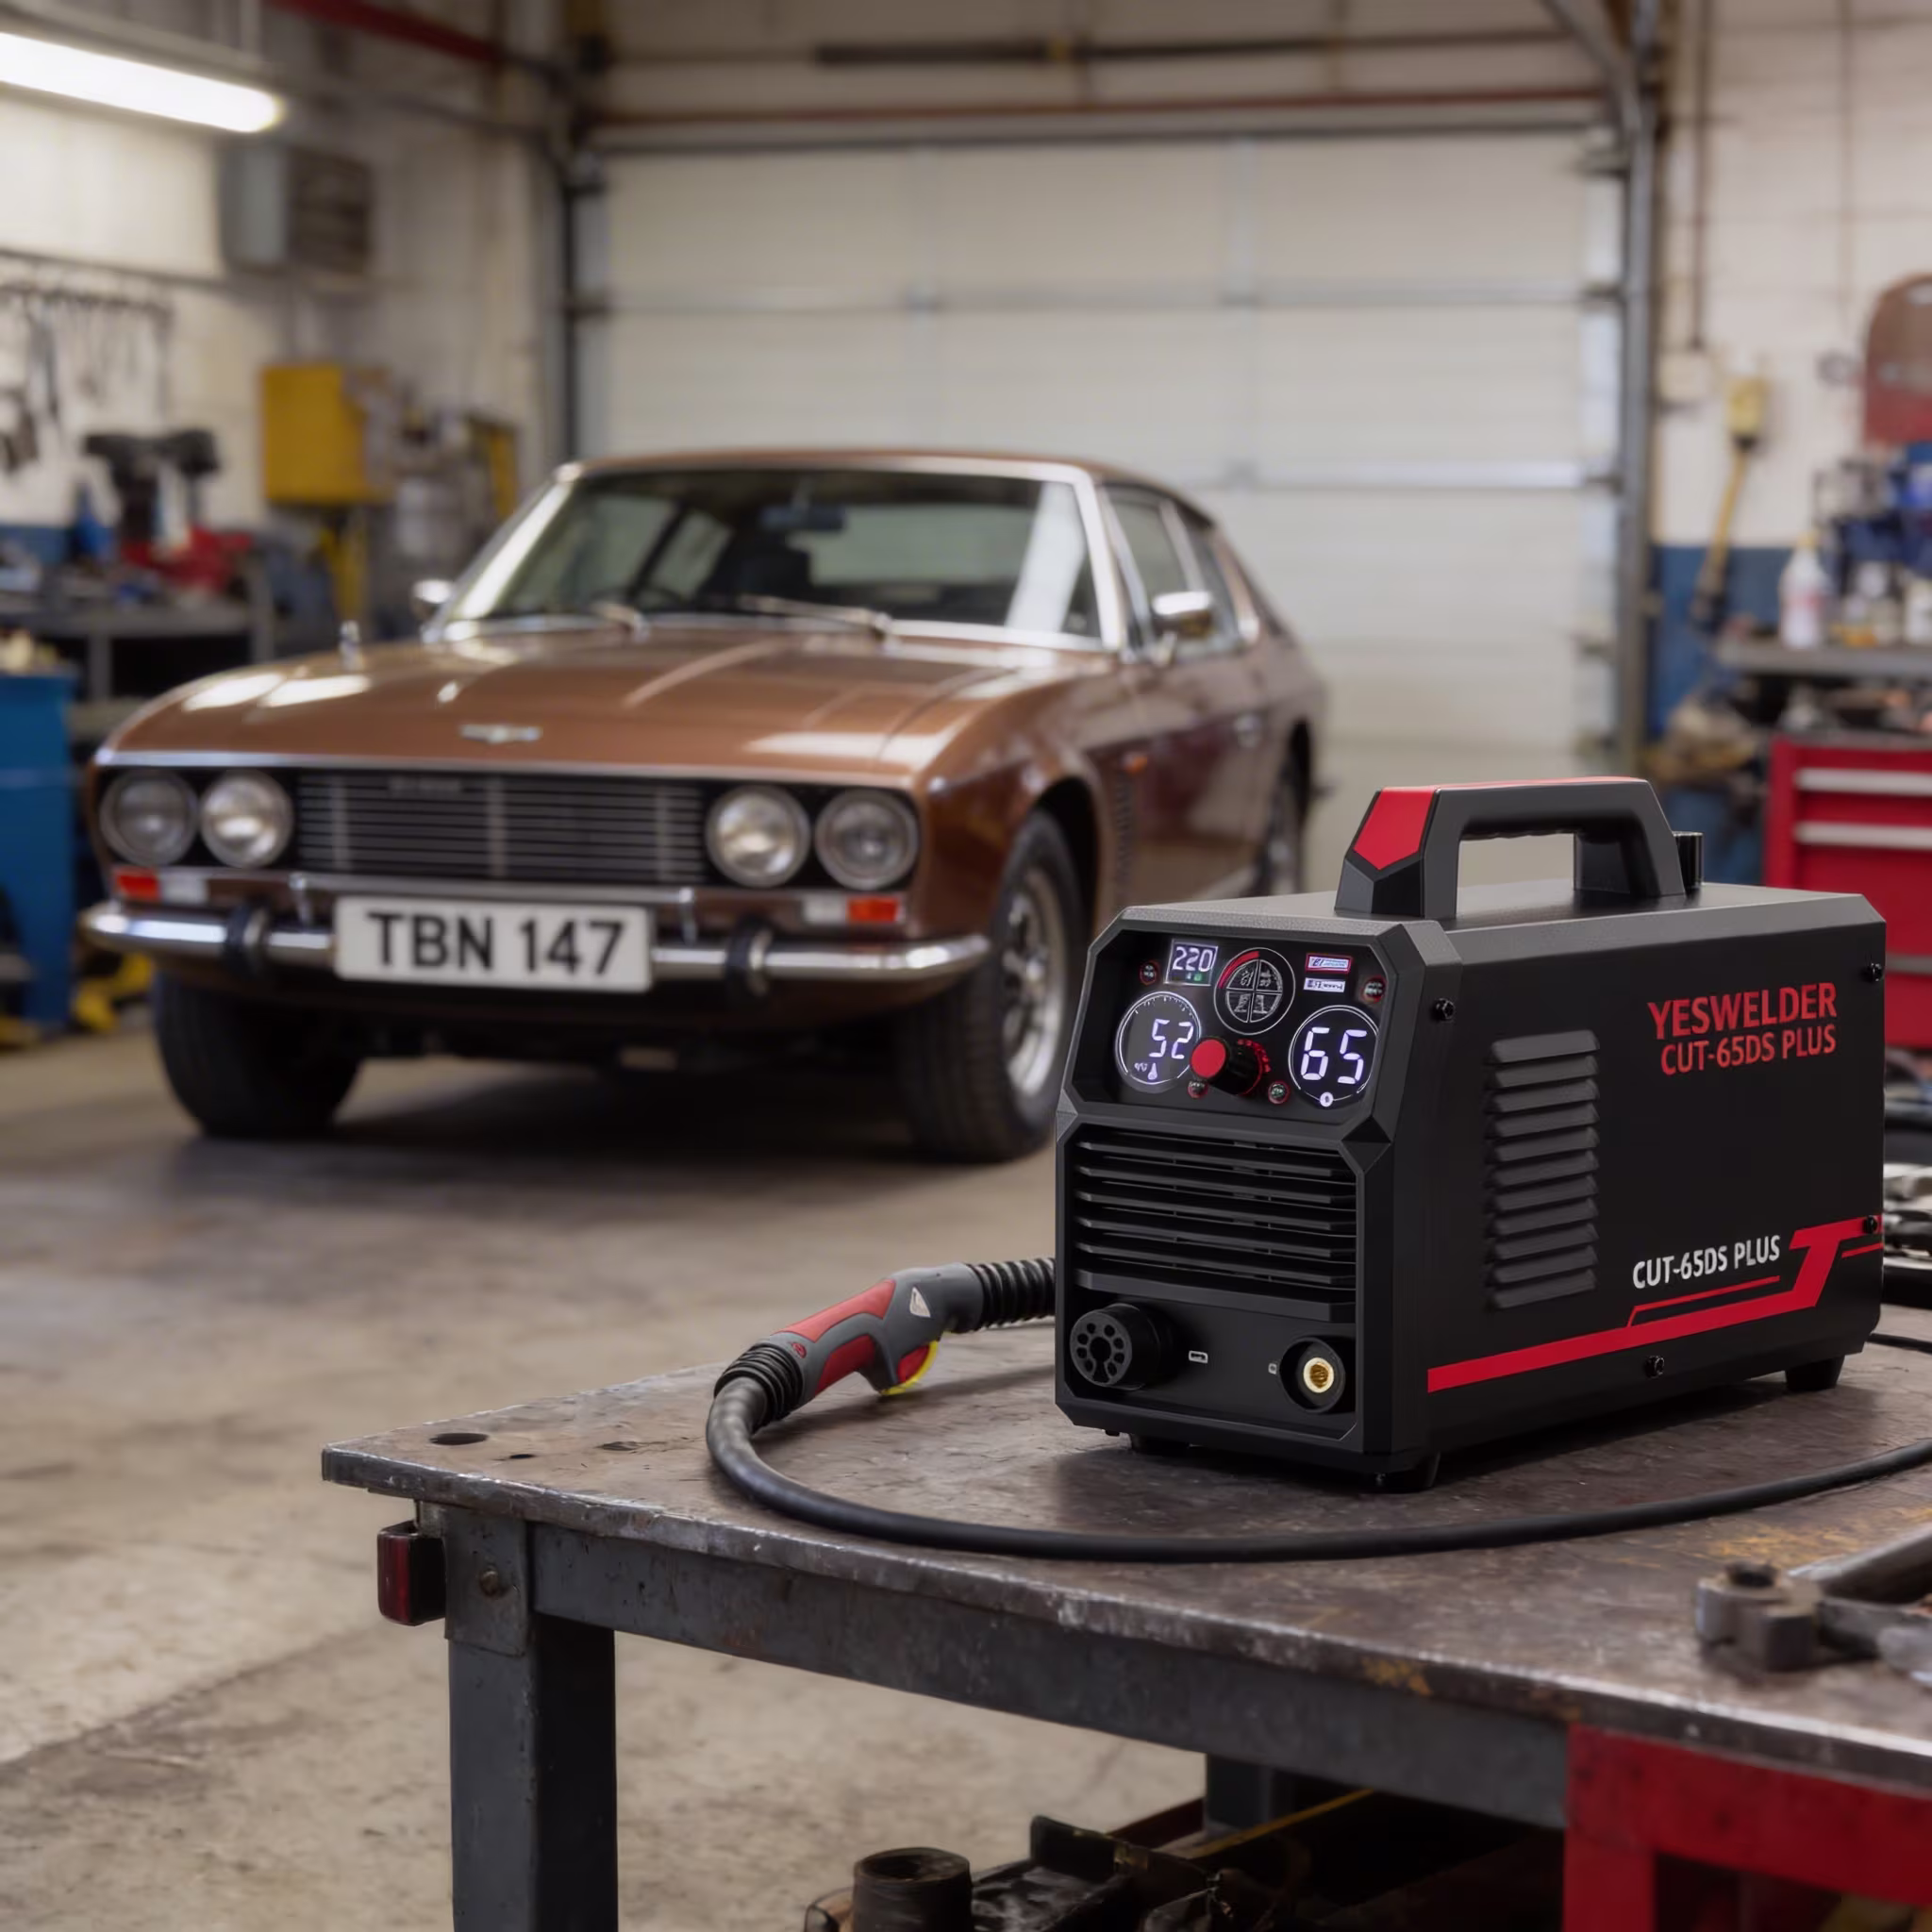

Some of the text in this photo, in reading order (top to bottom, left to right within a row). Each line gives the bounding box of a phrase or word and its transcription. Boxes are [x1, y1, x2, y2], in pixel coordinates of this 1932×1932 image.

[367, 912, 625, 975] TBN 147
[1172, 946, 1213, 972] 220
[1648, 982, 1837, 1040] YESWELDER
[1149, 1018, 1193, 1059] 52
[1301, 1026, 1367, 1084] 65
[1661, 1024, 1837, 1075] CUT-65DS PLUS
[1633, 1235, 1781, 1289] CUT-65DS PLUS
